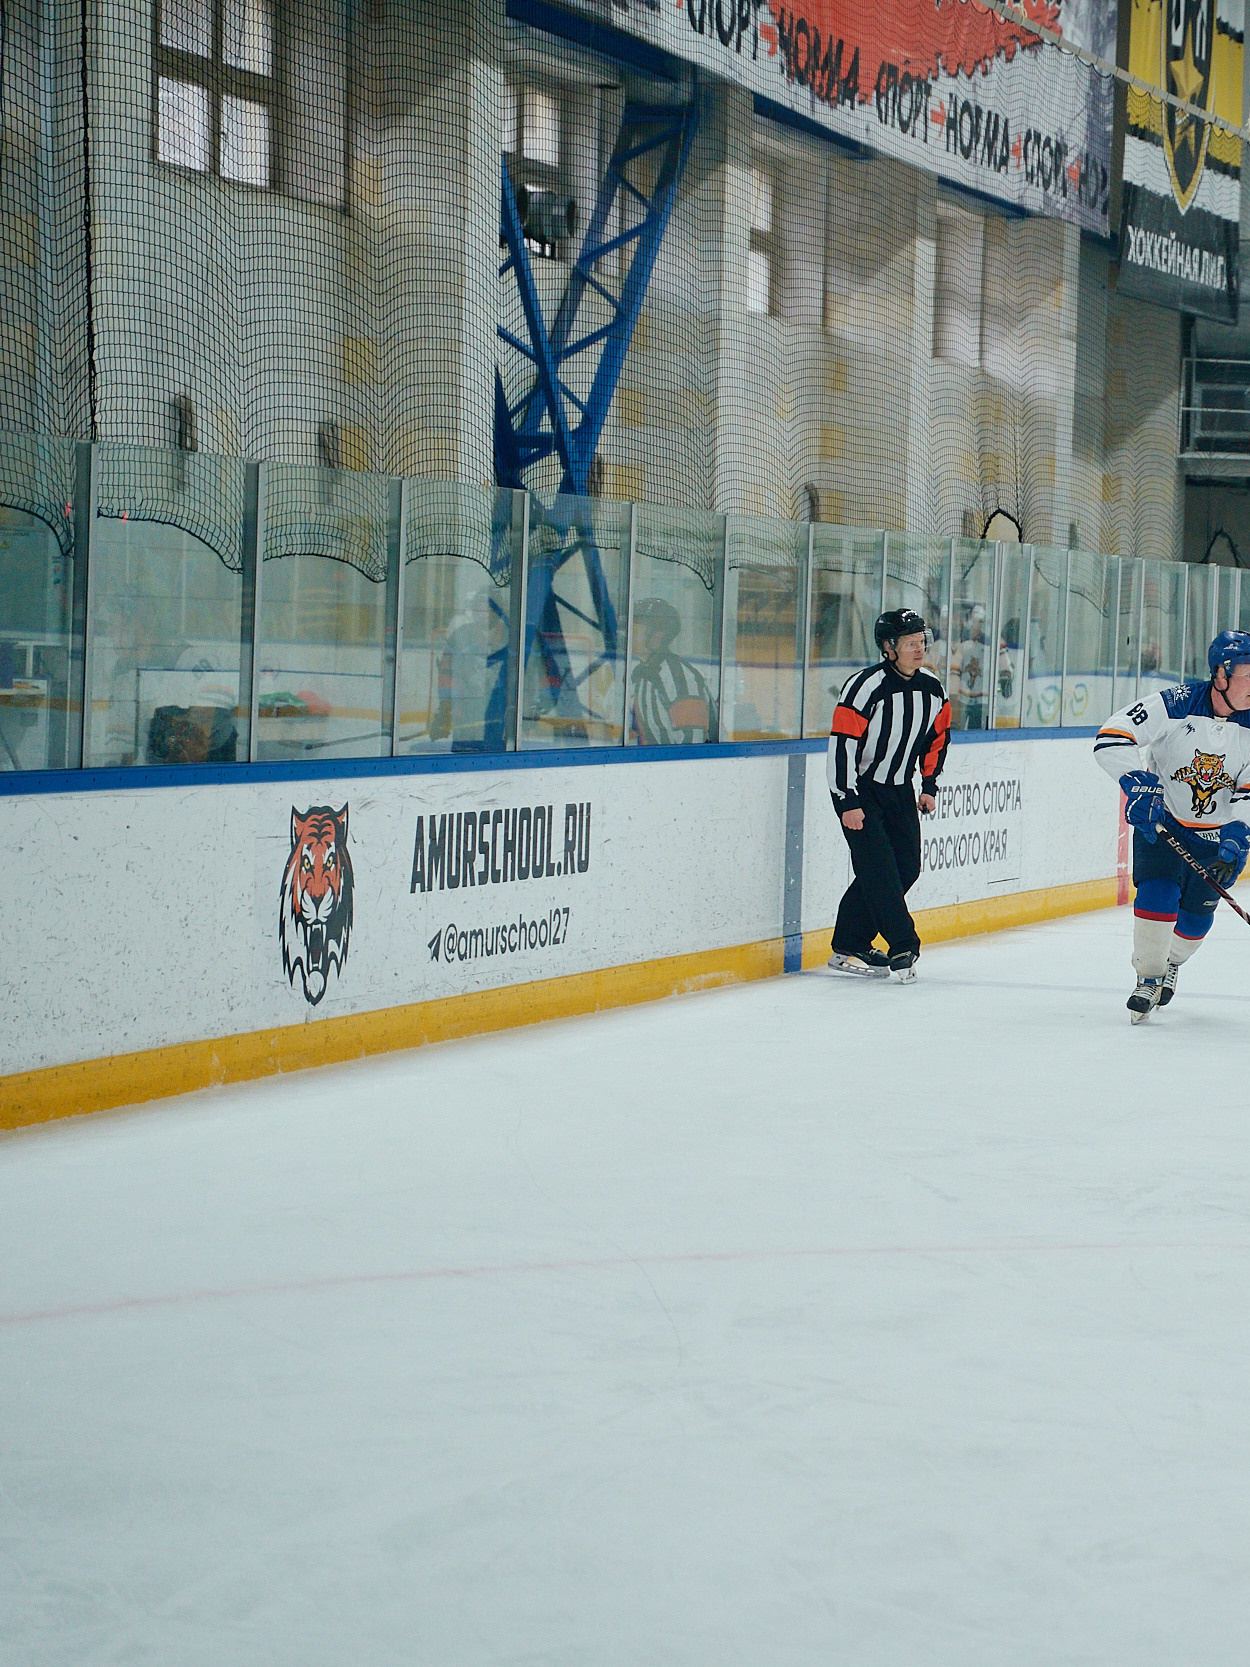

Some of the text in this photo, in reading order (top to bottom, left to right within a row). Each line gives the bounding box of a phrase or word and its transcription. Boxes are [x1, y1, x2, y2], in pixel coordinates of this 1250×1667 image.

[946, 93, 1009, 175] НОРМА
[1127, 224, 1200, 283] ХОККЕЙНАЯ
[983, 779, 1022, 814] СПОРТА
[410, 802, 592, 894] AMURSCHOOL.RU
[920, 828, 1008, 872] РОВСКОГО КРАЯ
[444, 907, 570, 963] @amurschool27
